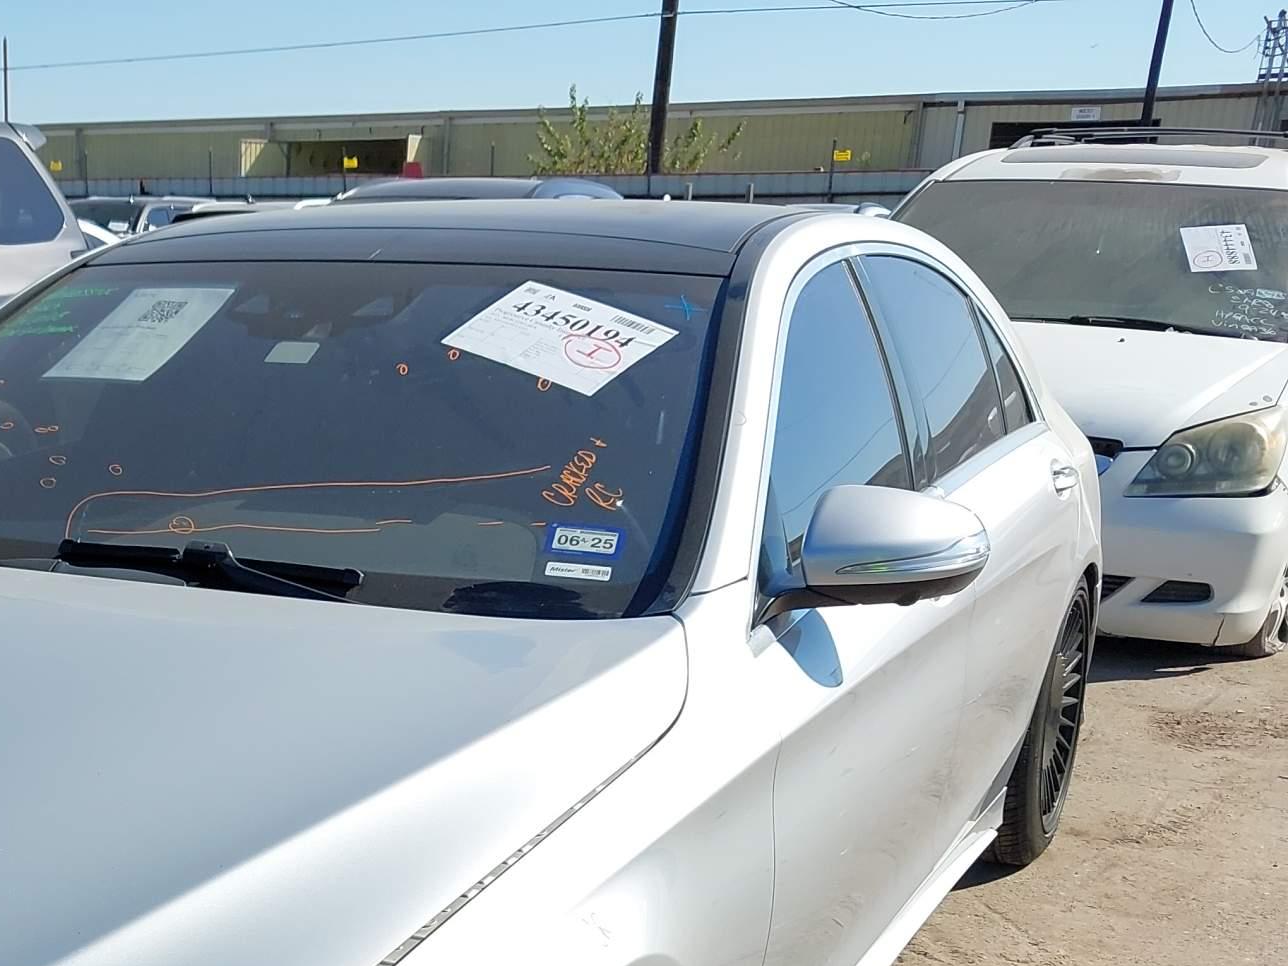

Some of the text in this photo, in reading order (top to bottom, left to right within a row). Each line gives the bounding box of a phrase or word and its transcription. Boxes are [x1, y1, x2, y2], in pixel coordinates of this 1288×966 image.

[512, 301, 638, 348] 43450194
[557, 534, 615, 550] 06 25
